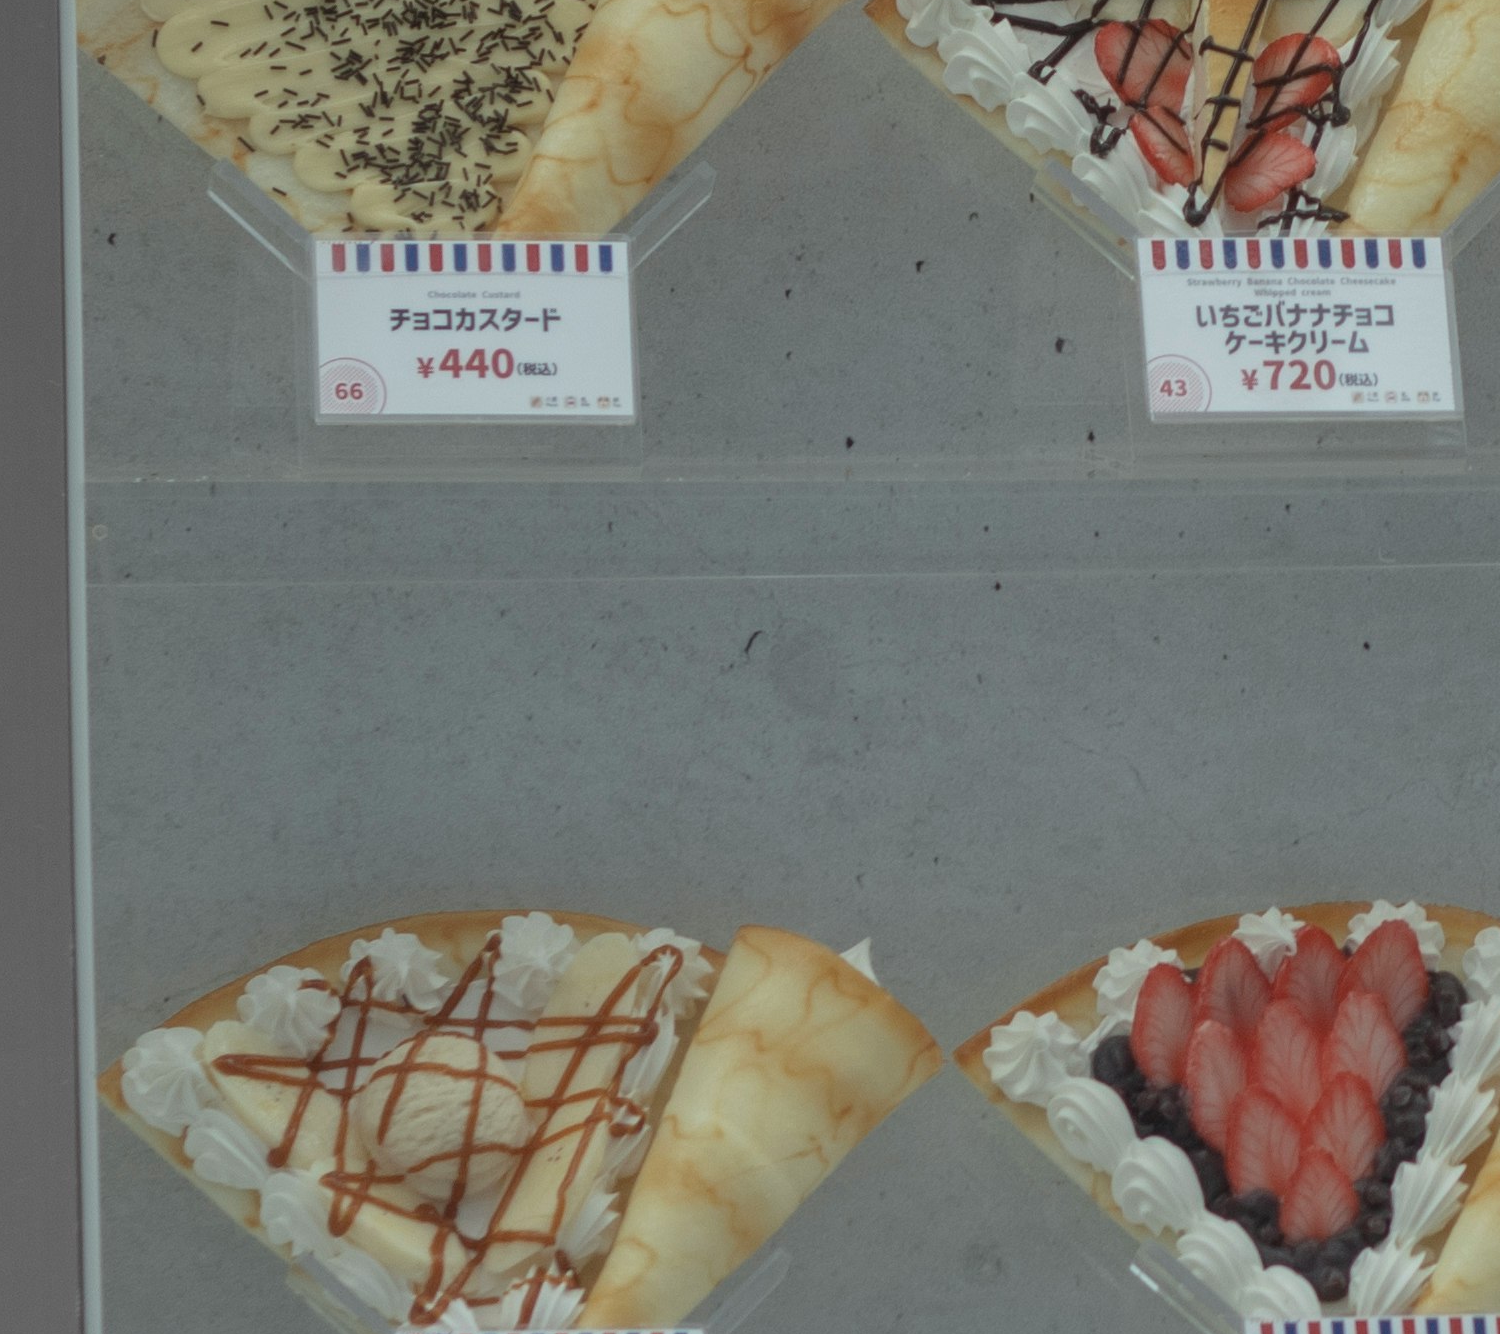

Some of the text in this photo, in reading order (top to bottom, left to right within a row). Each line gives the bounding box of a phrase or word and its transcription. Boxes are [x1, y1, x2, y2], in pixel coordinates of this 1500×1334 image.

[390, 308, 561, 332] チョコカスタード
[1196, 301, 1394, 328] いちごバナナチョコ
[1225, 331, 1369, 354] ケーキクリーム
[417, 349, 514, 379] ¥440
[1242, 360, 1336, 391] ¥720
[335, 383, 363, 400] 66
[1160, 380, 1188, 397] 43
